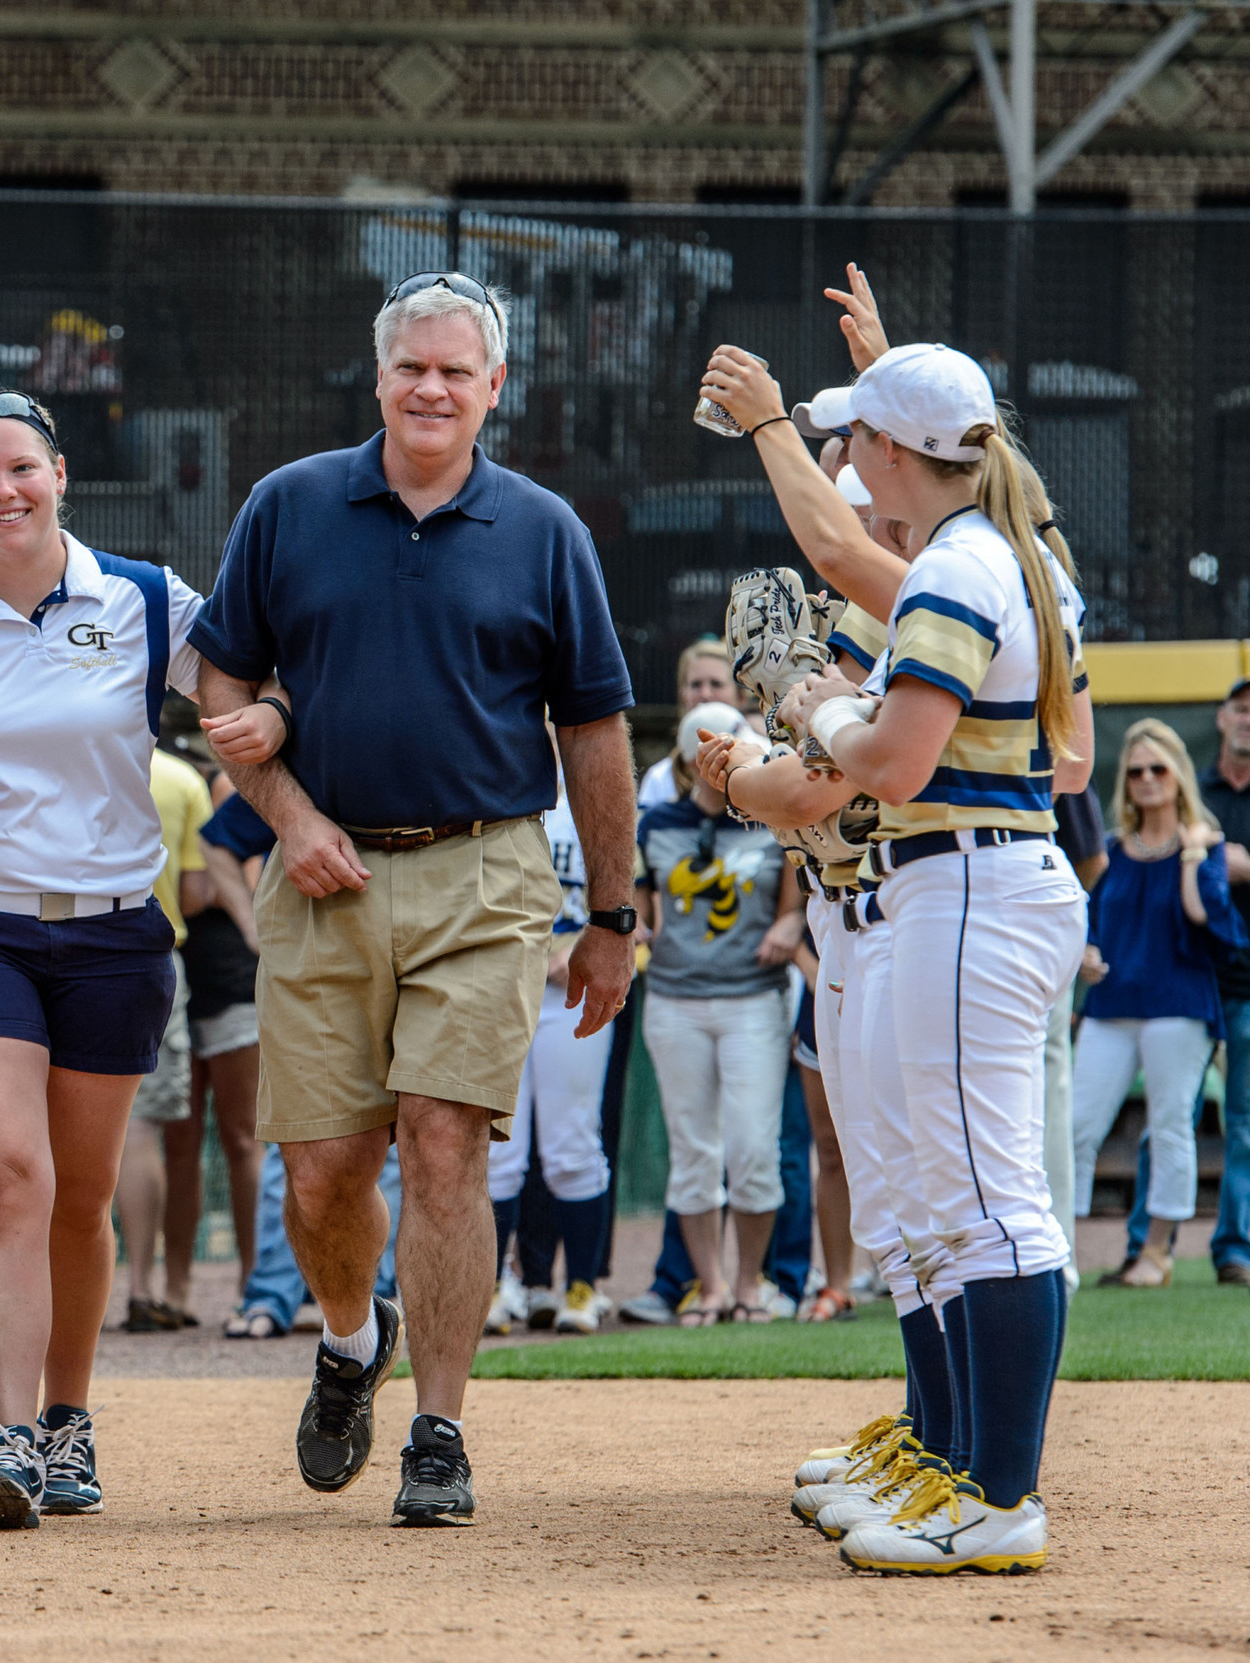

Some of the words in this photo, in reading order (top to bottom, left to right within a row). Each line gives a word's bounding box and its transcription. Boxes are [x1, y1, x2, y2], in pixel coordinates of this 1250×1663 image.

[770, 615, 785, 635] Tech
[67, 623, 114, 650] GT
[769, 650, 781, 664] 2
